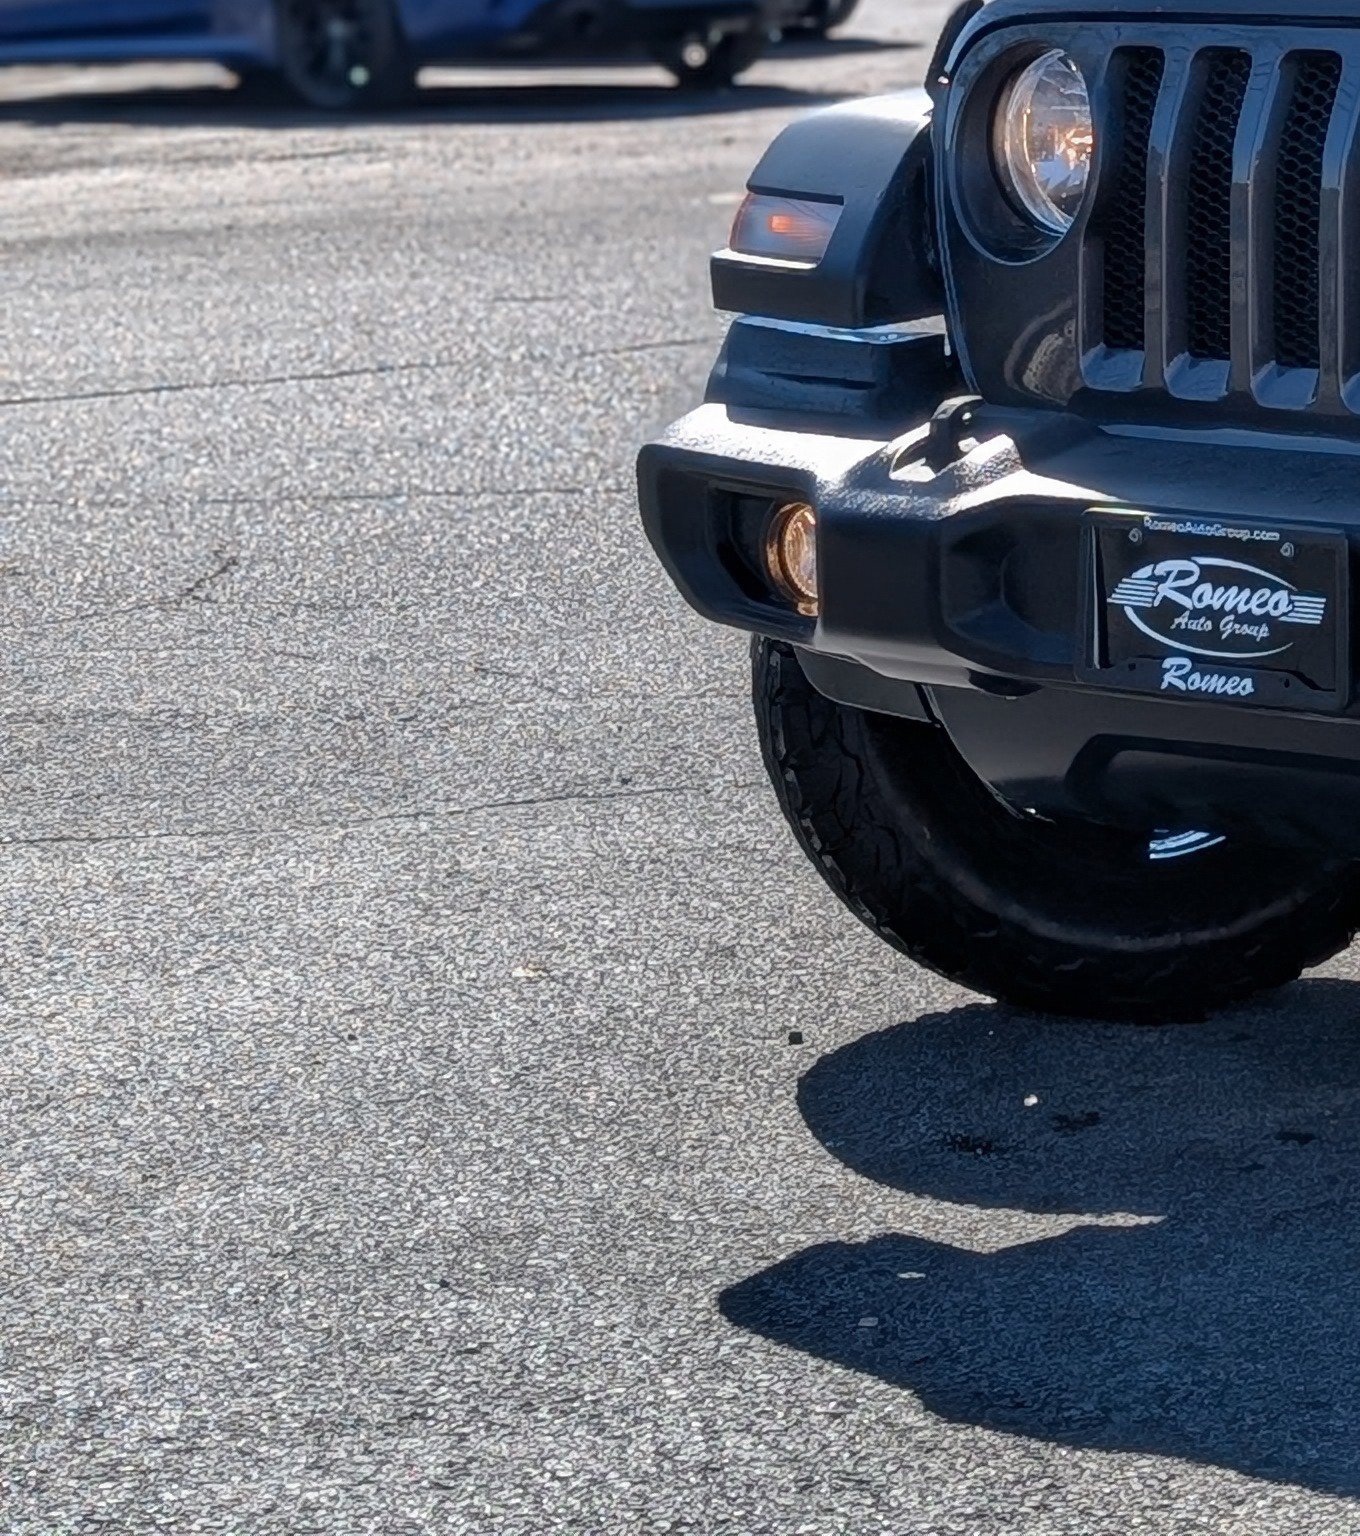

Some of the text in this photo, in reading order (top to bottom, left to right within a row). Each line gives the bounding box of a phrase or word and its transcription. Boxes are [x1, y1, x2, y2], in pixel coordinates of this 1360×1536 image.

[1144, 515, 1280, 541] RomeoAutoGroup.com
[1153, 559, 1294, 616] Romeo
[1170, 610, 1270, 641] Auto Group
[1160, 657, 1254, 696] Romeo
